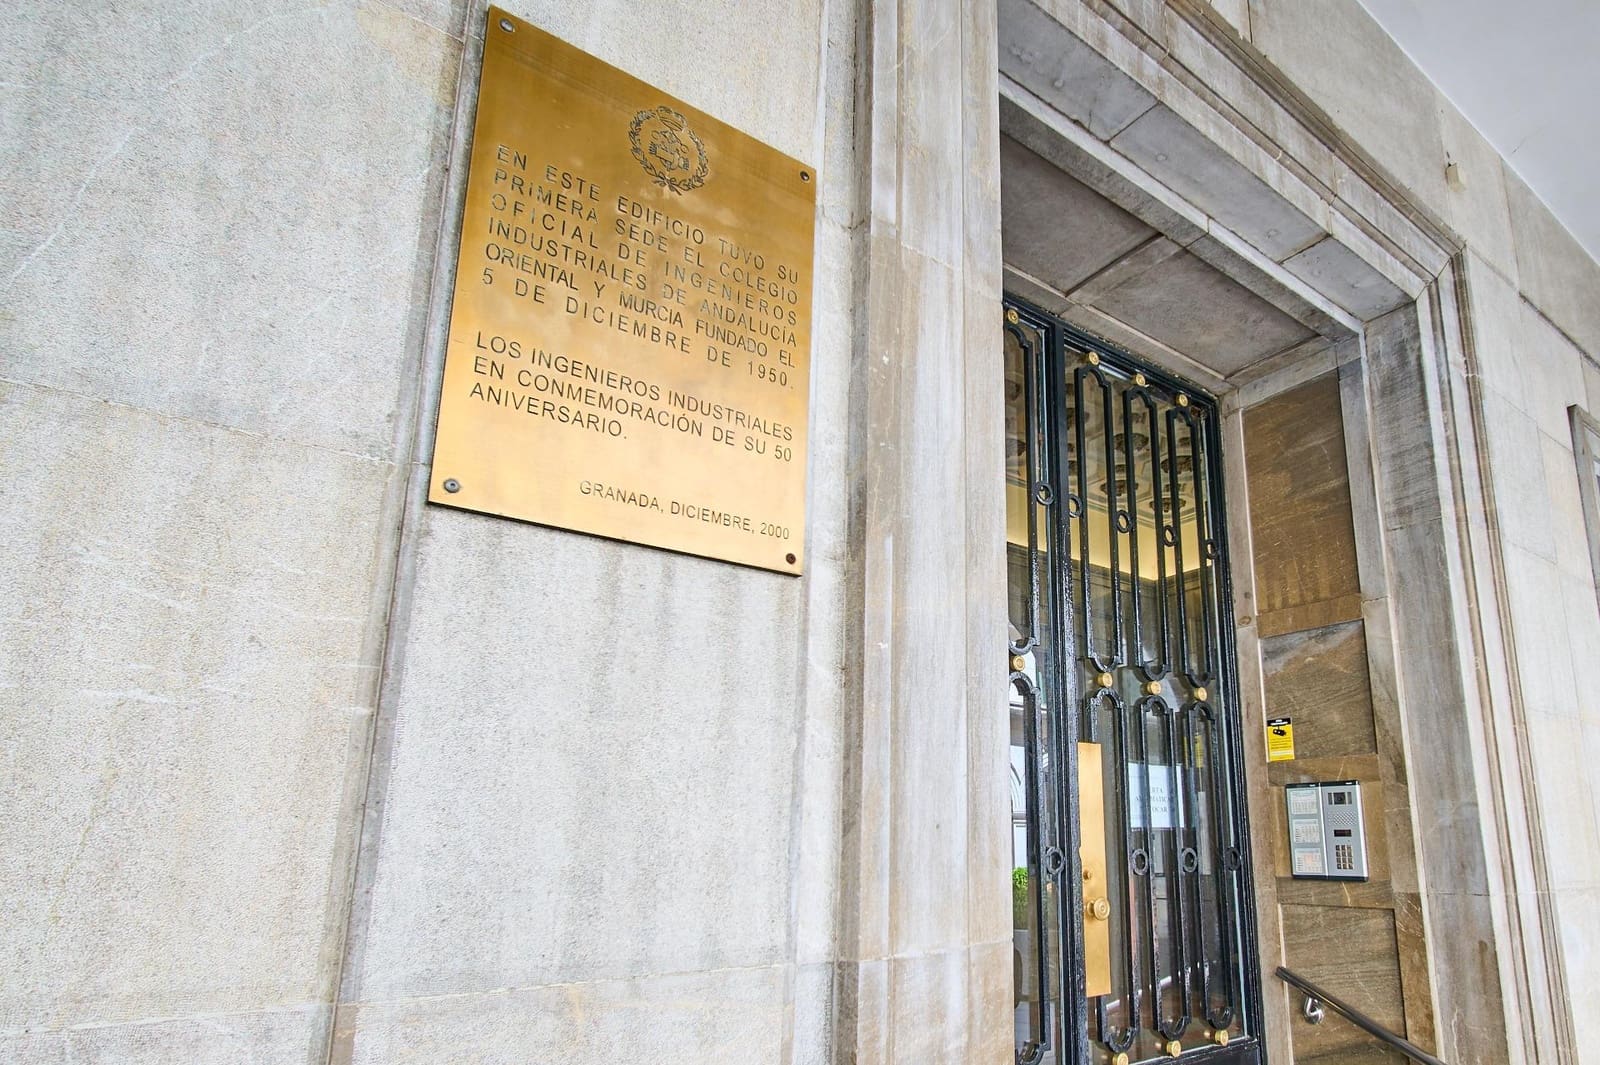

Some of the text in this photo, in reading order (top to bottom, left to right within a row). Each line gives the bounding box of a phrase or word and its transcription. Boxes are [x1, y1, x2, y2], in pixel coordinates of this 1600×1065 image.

[491, 193, 796, 326] OFICIAL DE INGENIEROS
[494, 168, 798, 305] PRIMERA SEDE EL COLEGIO
[497, 144, 798, 284] EN ESTE EDIFICIO TUVO SU
[482, 267, 794, 390] 5 DE DICIEMBRE DE 1950.
[485, 243, 795, 368] ORIENTAL Y MURCIA FUNDADO EL
[489, 216, 797, 347] INDUSTRIALES DE ANDALUCÍA
[469, 382, 627, 440] ANIVERSARIO.
[473, 356, 792, 462] EN CONMEMORACIÓN DE SU 50
[477, 331, 793, 442] LOS INGENIEROS INDUSTRIALES
[579, 480, 789, 540] GRANADA, DICIEMBRE, 2000
